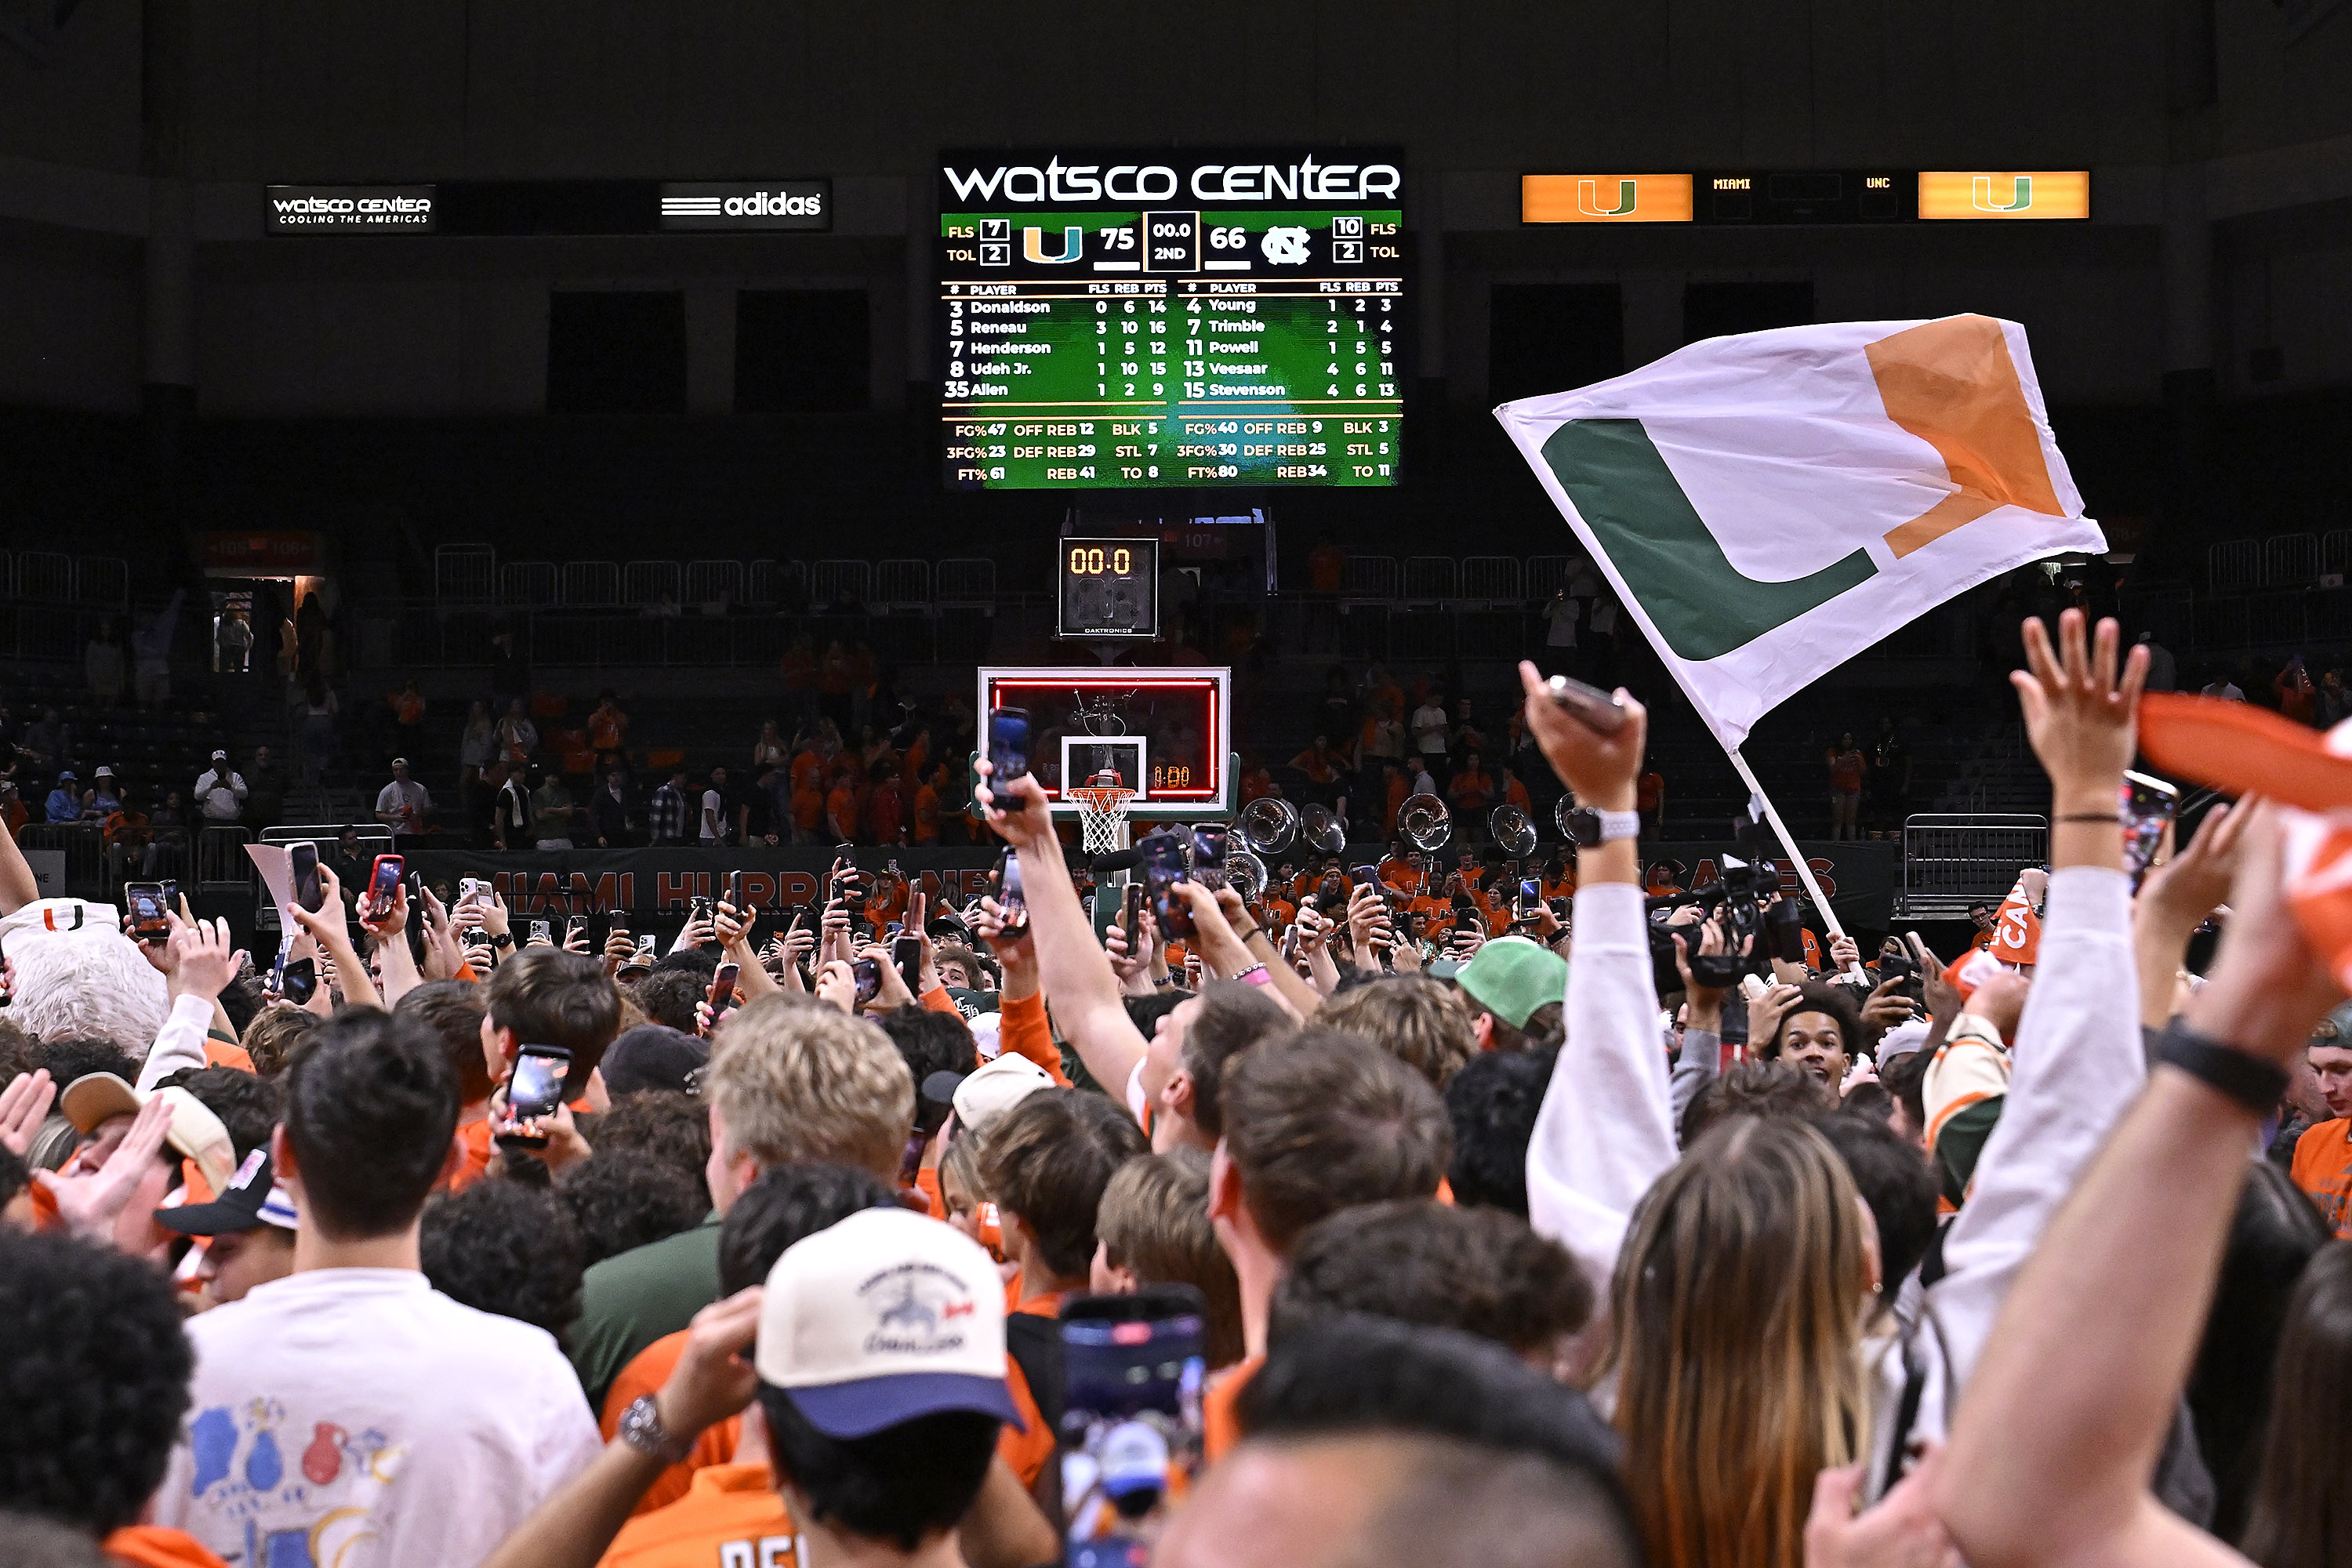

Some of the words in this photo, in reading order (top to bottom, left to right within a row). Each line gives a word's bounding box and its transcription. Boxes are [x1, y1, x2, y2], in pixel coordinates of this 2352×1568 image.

[1714, 179, 1750, 190] MIAMI
[1867, 178, 1889, 188] UNC
[724, 191, 821, 216] adidas
[949, 227, 974, 238] FLS
[987, 221, 1003, 236] 7
[1153, 223, 1190, 237] 00.0
[1338, 219, 1359, 234] 10
[1371, 223, 1396, 234] FLS
[1101, 228, 1134, 249] 75
[1210, 227, 1246, 249] 66
[947, 250, 976, 261] TOL
[988, 245, 1002, 260] 2
[1155, 248, 1185, 260] 2ND
[1343, 245, 1355, 258] 2
[1370, 247, 1399, 257] TOL
[971, 285, 1016, 295] PLAYER
[1089, 285, 1109, 293] FLS
[1115, 284, 1139, 293] REB
[1145, 284, 1167, 293] PTS
[1210, 284, 1256, 292] PLAYER
[1320, 282, 1341, 292] FLS
[1346, 282, 1370, 292] REB
[1376, 282, 1398, 291] PTS
[950, 302, 963, 318] 3
[971, 301, 1050, 313] Donaldson
[1096, 301, 1107, 314] 0
[1124, 300, 1134, 313] 6
[1149, 300, 1167, 313] 14
[1187, 298, 1201, 314] 4
[1209, 299, 1256, 313] Young
[1329, 299, 1335, 311] 1
[1356, 299, 1365, 311] 2
[1381, 299, 1391, 311] 3
[950, 320, 963, 336] 5
[971, 322, 1026, 333] Reneau
[1097, 321, 1106, 334] 3
[1121, 321, 1138, 333] 10
[1149, 321, 1166, 333] 16
[1188, 319, 1200, 335] 7
[1208, 319, 1265, 332] Trimble
[1327, 321, 1338, 332] 2
[1357, 320, 1363, 332] 1
[1381, 320, 1392, 332] 4
[950, 341, 964, 357] 7
[971, 342, 1051, 354] Henderson
[1098, 343, 1105, 354] 1
[1125, 342, 1134, 354] 5
[1150, 342, 1166, 354] 12
[1186, 339, 1202, 355] 11
[1210, 341, 1258, 353] Powell
[1329, 342, 1335, 354] 1
[1356, 342, 1366, 354] 5
[1381, 341, 1392, 354] 5
[950, 361, 964, 377] 8
[971, 362, 1010, 375] Udeh
[1014, 363, 1031, 374] Jr.
[1098, 363, 1105, 375] 1
[1121, 362, 1138, 375] 10
[1150, 362, 1166, 375] 15
[1184, 361, 1204, 376] 13
[1209, 363, 1268, 374] Veesaar
[1327, 363, 1338, 375] 4
[1356, 362, 1366, 375] 6
[1380, 362, 1392, 375] 11
[945, 381, 969, 397] 35
[971, 383, 1007, 395] Allen
[1098, 383, 1105, 396] 1
[1125, 383, 1134, 396] 2
[1153, 383, 1163, 395] 9
[1184, 382, 1205, 398] 15
[1210, 384, 1285, 395] Stevenson
[1327, 384, 1338, 397] 4
[1356, 384, 1366, 396] 6
[1379, 383, 1394, 396] 13
[956, 425, 987, 437] FG%
[988, 423, 1006, 435] 47
[1014, 425, 1043, 436] OFF
[1047, 425, 1076, 436] REB
[1080, 423, 1094, 434] 12
[1112, 424, 1142, 435] BLK
[1149, 423, 1157, 434] 5
[1185, 423, 1217, 434] FG%
[1218, 422, 1238, 434] 40
[1244, 423, 1272, 434] OFF
[1277, 423, 1307, 434] REB
[1312, 421, 1322, 433] 9
[1344, 423, 1373, 434] BLK
[1379, 421, 1388, 432] 3
[947, 447, 987, 459] 3FG%
[989, 445, 1006, 457] 23
[1014, 447, 1043, 458] DEF
[1047, 447, 1076, 457] REB
[1078, 445, 1095, 456] 29
[1116, 446, 1142, 457] STL
[1148, 445, 1157, 456] 7
[1178, 445, 1217, 456] 3FG%
[1218, 444, 1237, 456] 30
[1244, 445, 1273, 456] DEF
[1277, 445, 1307, 456] REB
[1309, 443, 1326, 455] 25
[1347, 444, 1373, 455] STL
[1379, 442, 1388, 454] 5
[959, 469, 987, 480] FT%
[990, 467, 1004, 479] 61
[1047, 468, 1077, 479] REB
[1080, 466, 1094, 478] 41
[1121, 467, 1142, 478] TO
[1149, 466, 1158, 477] 8
[1189, 467, 1218, 478] FT%
[1217, 466, 1237, 477] 80
[1278, 466, 1307, 477] REB
[1308, 465, 1327, 477] 34
[1352, 466, 1373, 477] TO
[1378, 464, 1389, 476] 11
[464, 870, 634, 916] MIAMI
